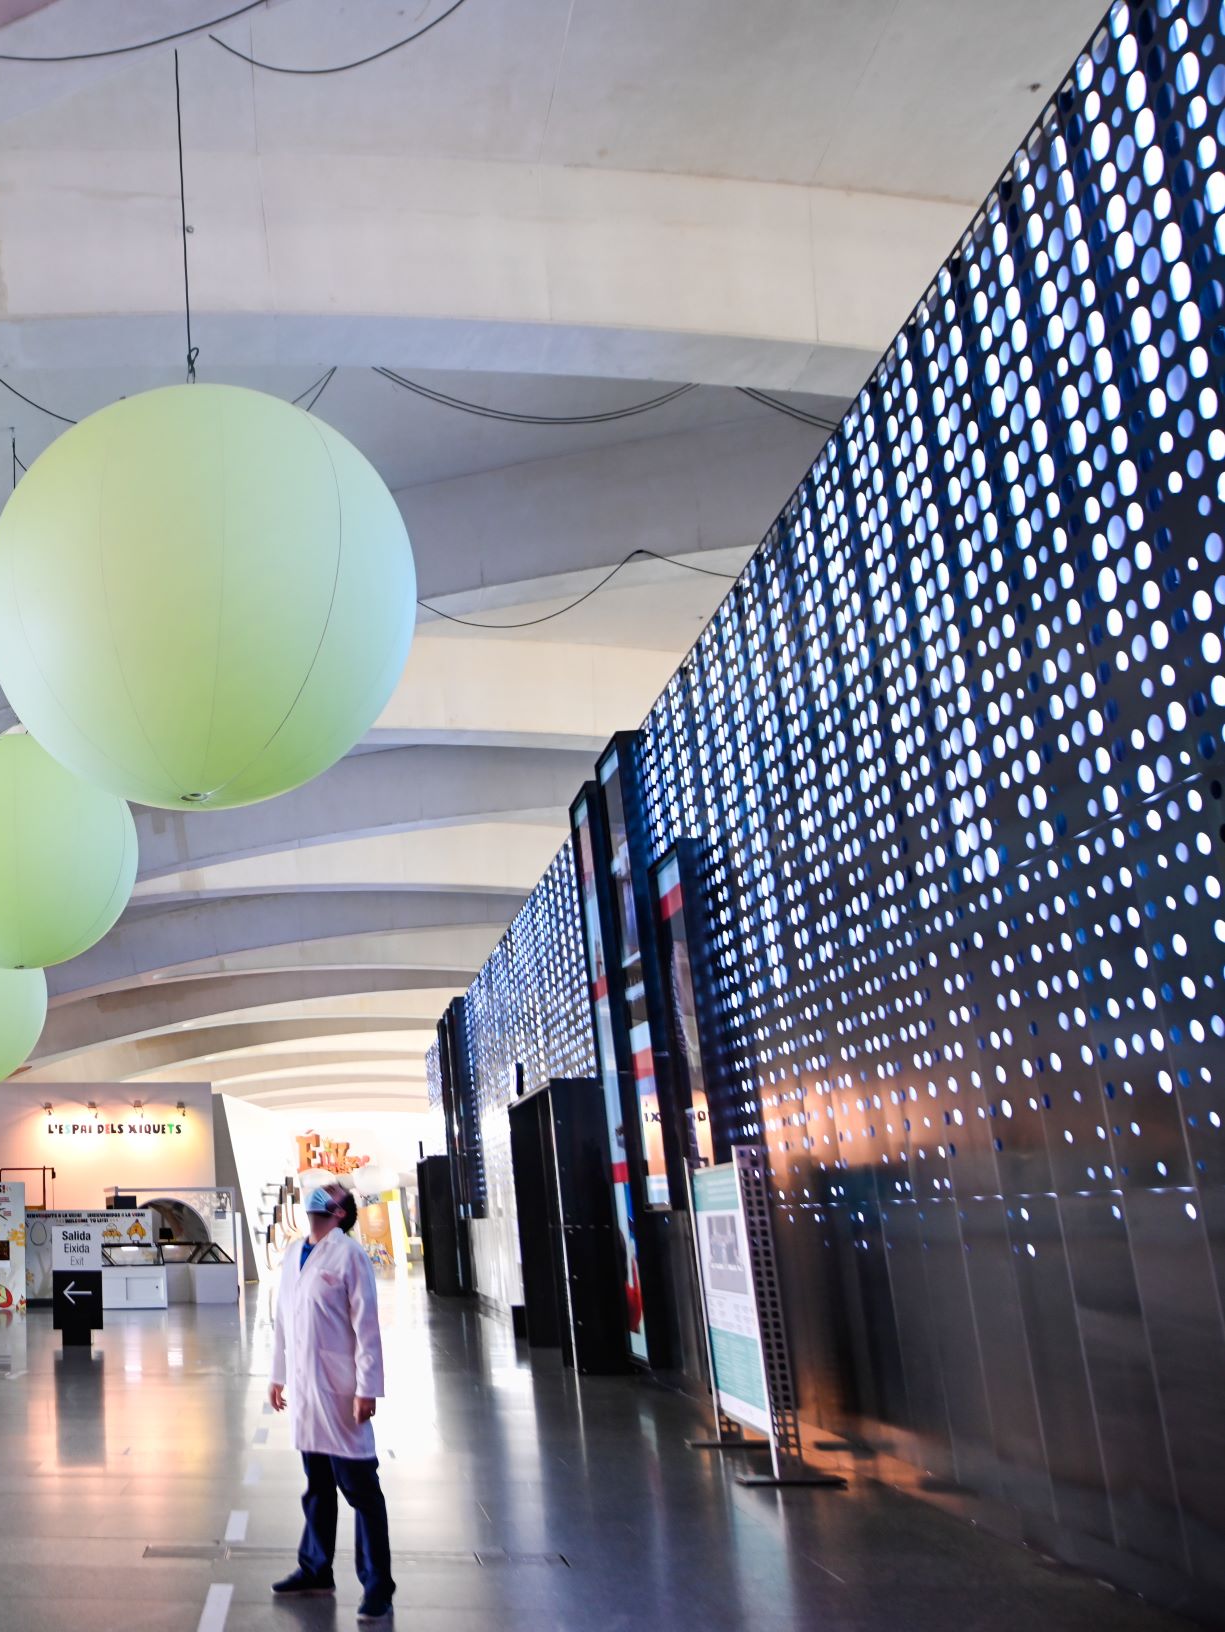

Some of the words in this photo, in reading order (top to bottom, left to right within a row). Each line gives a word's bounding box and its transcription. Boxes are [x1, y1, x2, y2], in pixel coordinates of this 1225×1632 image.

[48, 1124, 92, 1134] L'ESPAI
[97, 1124, 124, 1134] DELS
[128, 1124, 182, 1134] XIQUETS
[62, 1230, 91, 1241] Salida
[64, 1243, 90, 1253] Eixida
[70, 1256, 84, 1266] Exit
